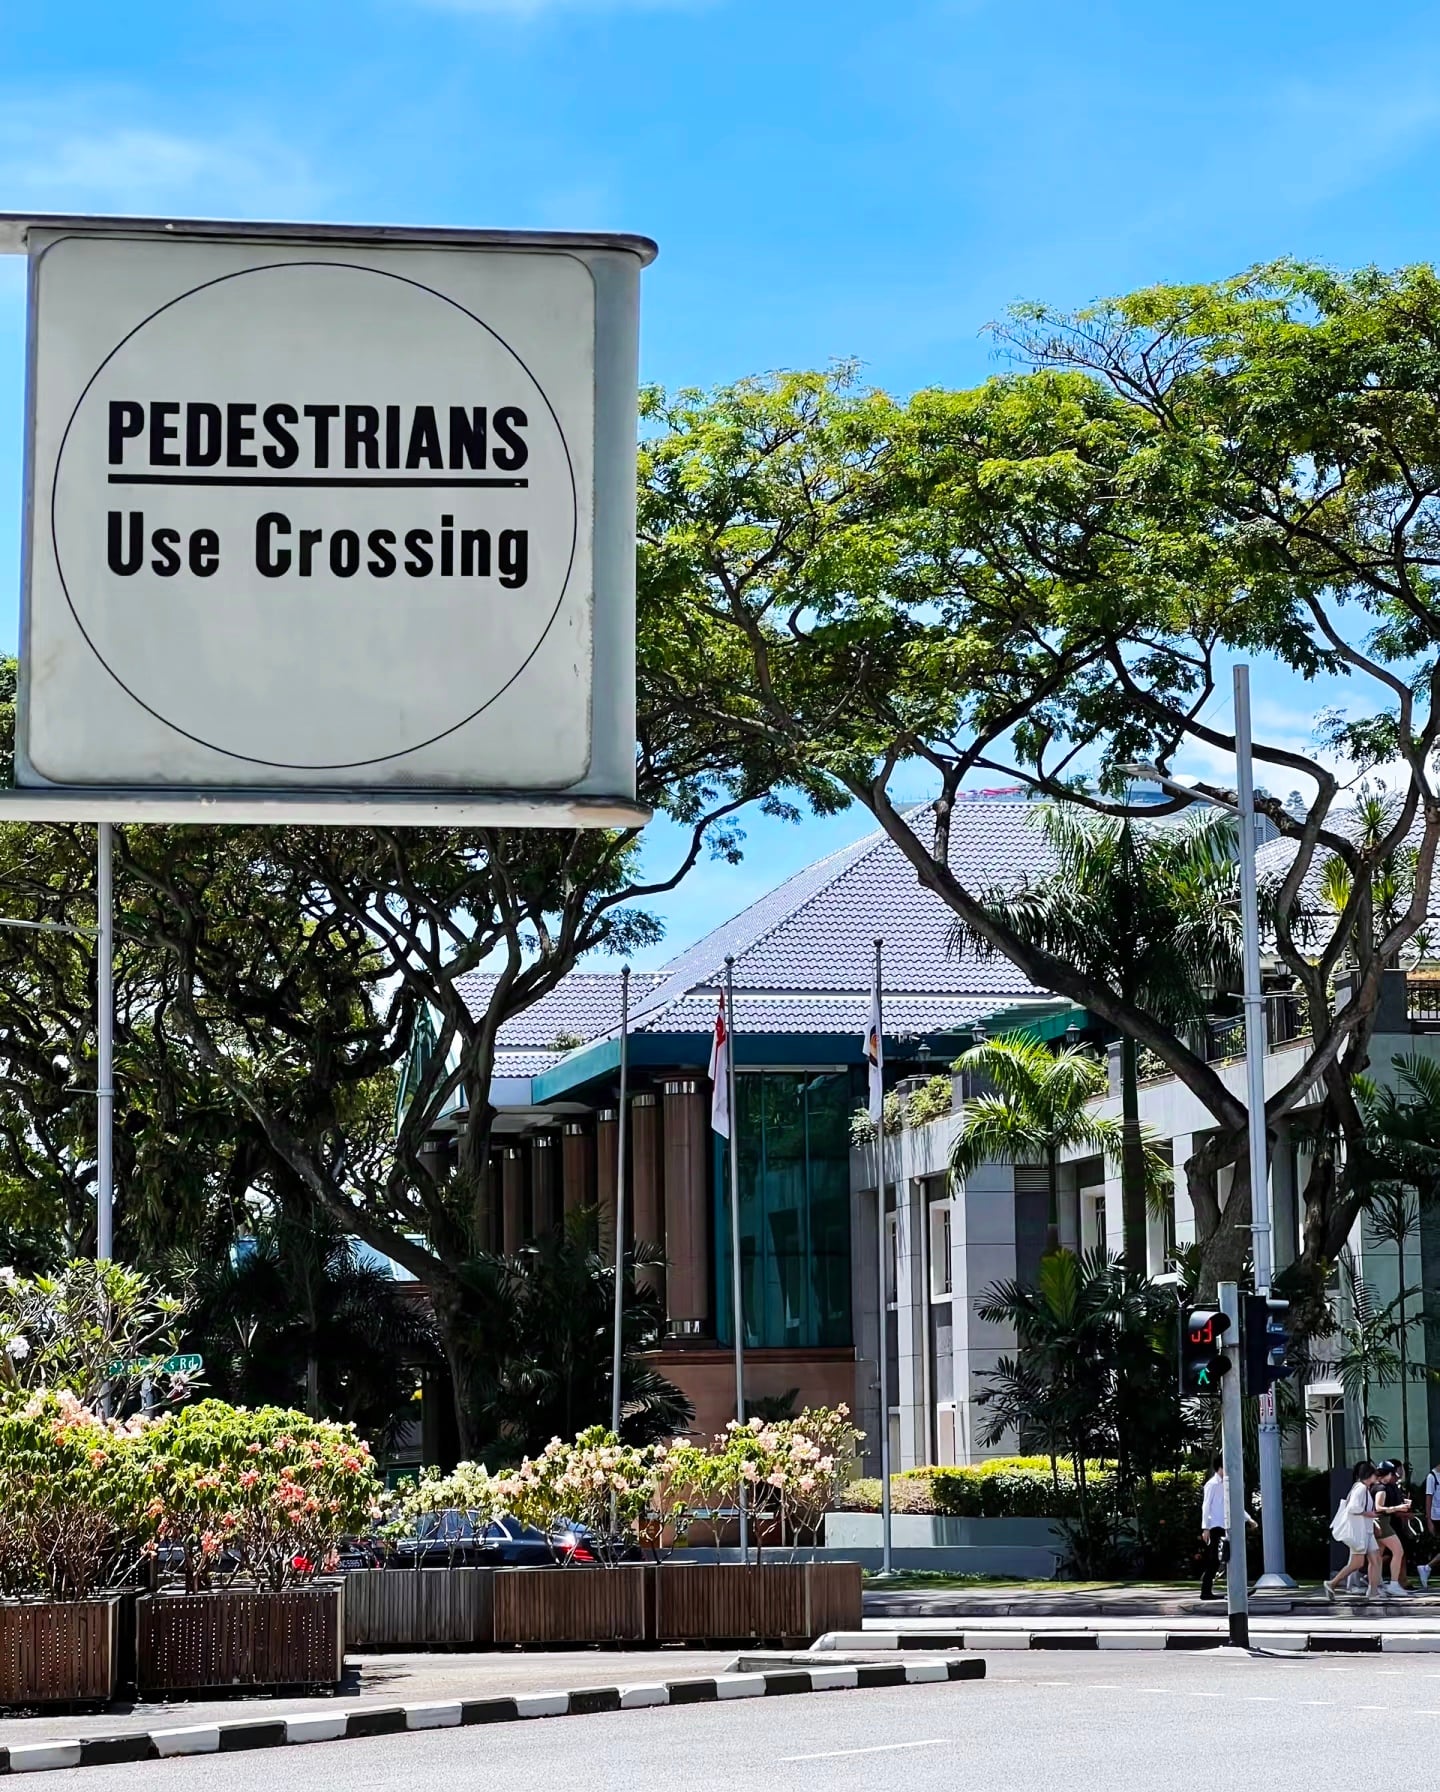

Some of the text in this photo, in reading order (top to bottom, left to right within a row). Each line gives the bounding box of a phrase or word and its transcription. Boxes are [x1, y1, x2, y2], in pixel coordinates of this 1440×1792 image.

[109, 401, 529, 471] PEDESTRIANS
[107, 511, 529, 588] Use Crossing
[180, 1357, 196, 1371] Rd
